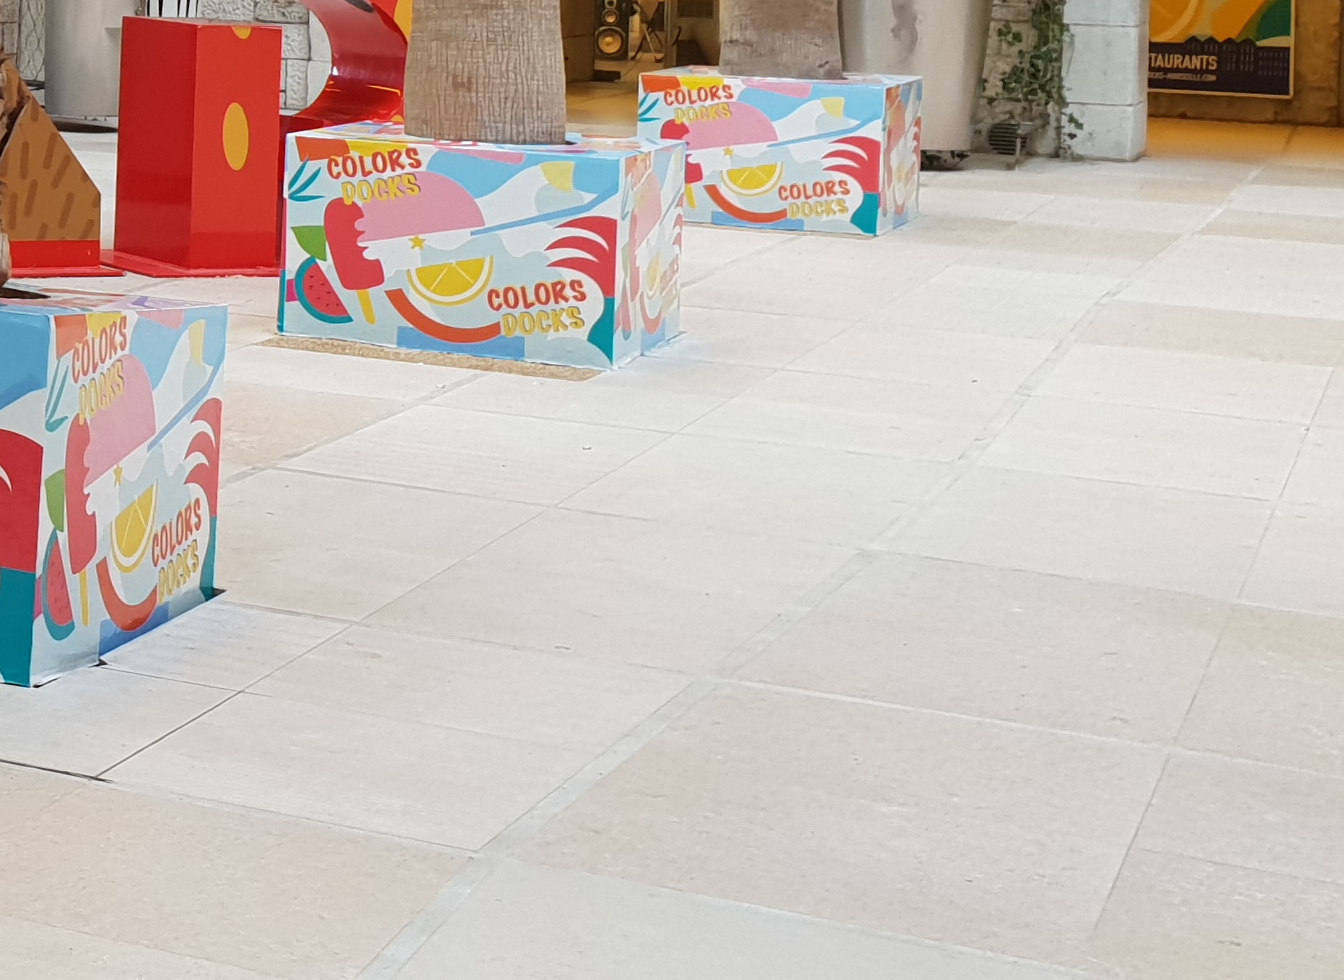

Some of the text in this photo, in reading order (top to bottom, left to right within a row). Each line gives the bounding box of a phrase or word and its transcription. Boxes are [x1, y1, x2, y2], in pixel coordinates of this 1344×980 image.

[663, 84, 734, 107] COLORS
[674, 103, 733, 125] DOCKS
[326, 147, 423, 180] COLORS
[341, 173, 421, 206] DOCKS
[778, 179, 851, 202] COLORS
[787, 198, 849, 220] DOCKS
[486, 278, 587, 312] COLORS
[501, 305, 586, 338] DOCKS
[71, 314, 128, 384] COLORS
[78, 359, 125, 425] DOCKS
[151, 496, 202, 568] COLORS
[158, 539, 200, 605] DOCKS
